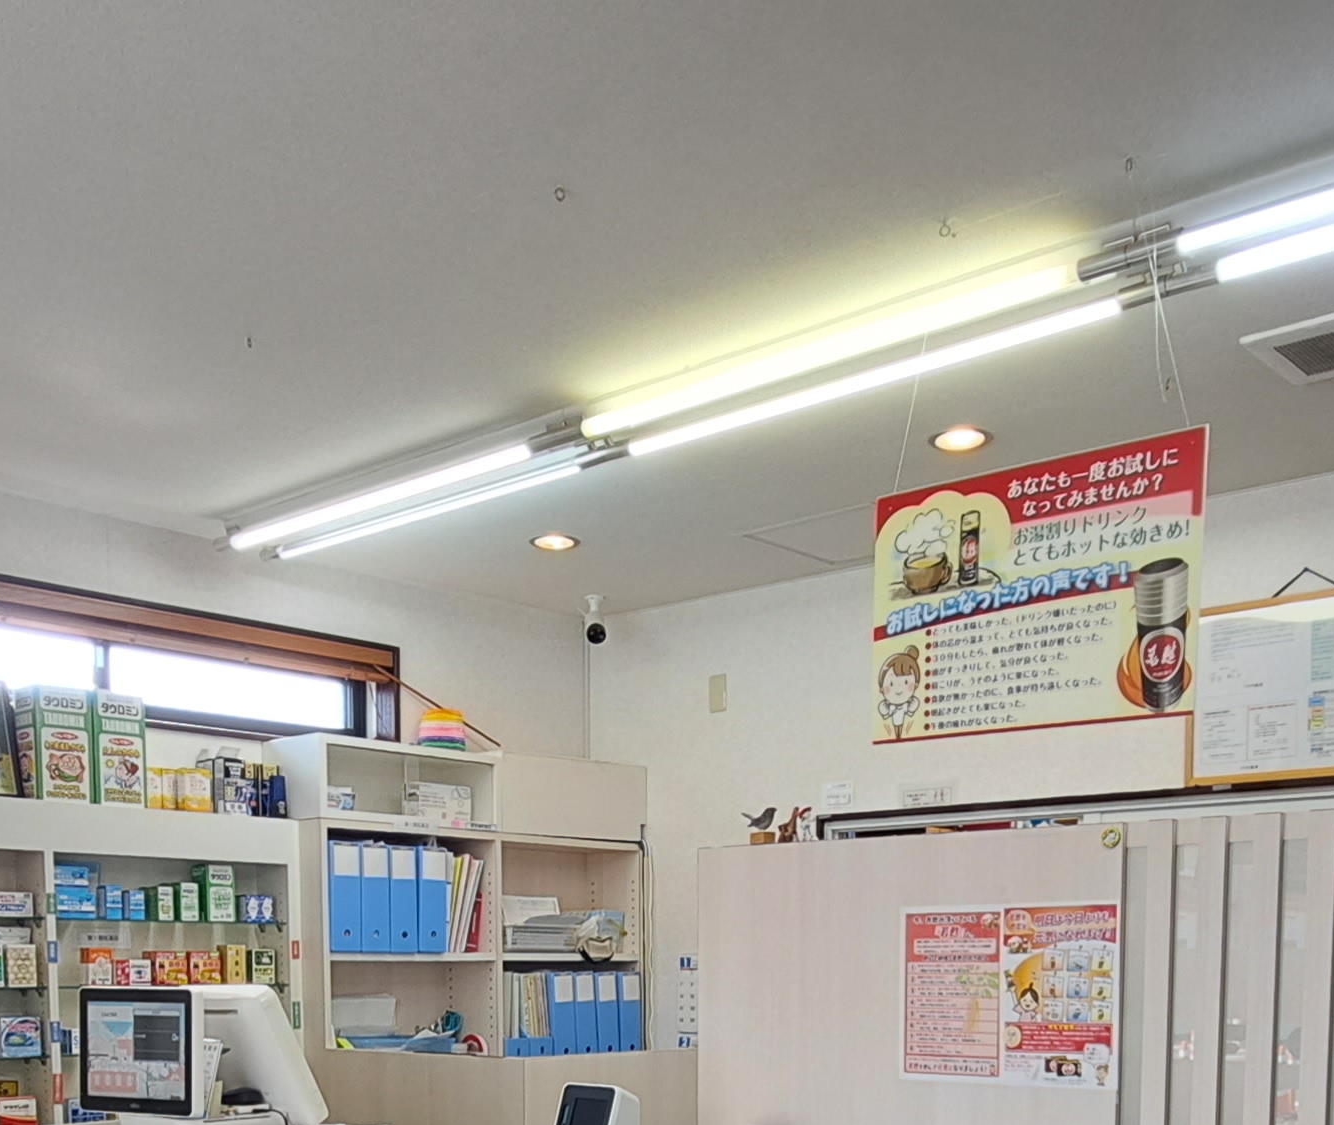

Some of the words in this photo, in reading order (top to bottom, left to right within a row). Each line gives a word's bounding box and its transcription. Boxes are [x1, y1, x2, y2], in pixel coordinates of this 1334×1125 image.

[1007, 448, 1179, 499] あなたも一度お試しに
[1022, 473, 1165, 517] なってみませんか？
[1013, 506, 1147, 544] お湯割りドリンク
[1013, 521, 1191, 566] とてもホットな効きめ!
[886, 561, 1131, 636] お試しになった方の声です！
